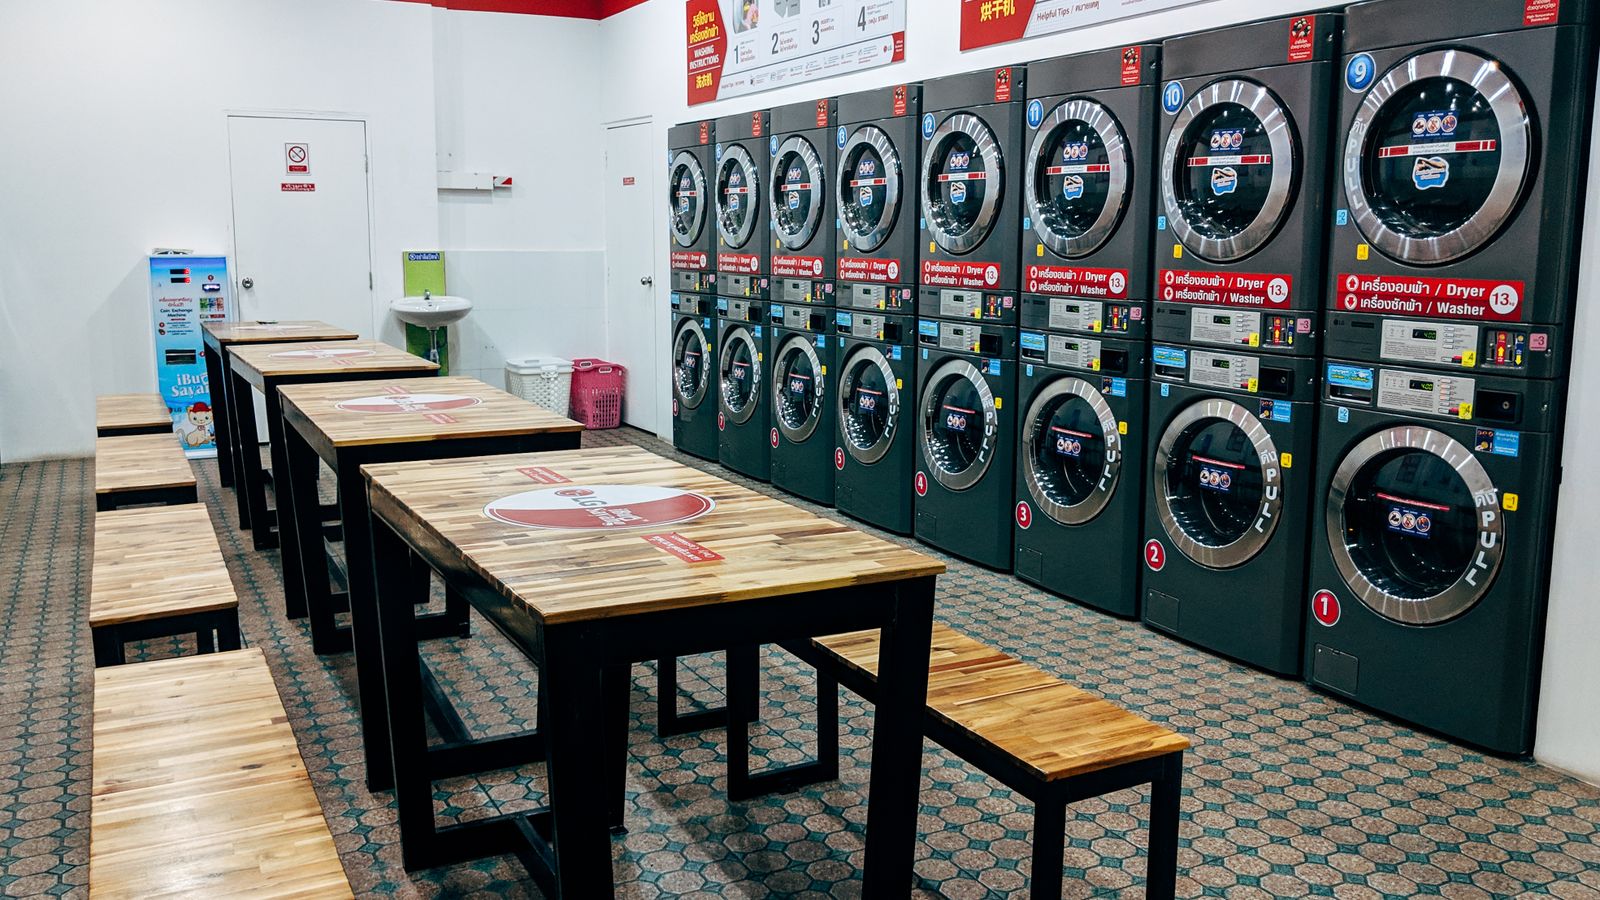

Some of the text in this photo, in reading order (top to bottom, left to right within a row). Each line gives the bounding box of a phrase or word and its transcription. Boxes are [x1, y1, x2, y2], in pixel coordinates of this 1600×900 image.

[858, 6, 866, 32] 4
[1037, 9, 1057, 20] Helpful
[1058, 7, 1070, 16] Tips
[812, 20, 820, 45] 3
[694, 45, 714, 58] WASHING
[772, 32, 779, 55] 2
[690, 54, 719, 70] INSTRUCTIONS
[734, 45, 739, 64] 1
[1354, 64, 1367, 83] 9
[1167, 87, 1181, 107] 10
[1030, 106, 1039, 122] 11
[924, 118, 932, 132] 12
[839, 132, 845, 144] 13
[1347, 140, 1363, 210] PULL
[967, 266, 984, 275] Dryer
[987, 271, 995, 279] 13
[1086, 272, 1107, 282] Dryer
[963, 278, 984, 286] Washer
[1110, 278, 1120, 288] 13
[1176, 272, 1224, 287] เครื่องอบผ้า
[1237, 278, 1264, 290] Dryer
[1361, 277, 1430, 295] เครื่องอบผ้า
[1447, 284, 1485, 299] Dryer
[1080, 286, 1107, 295] Washer
[1175, 287, 1219, 302] เครื่องซักผ้า
[1230, 295, 1264, 305] Washer
[1269, 284, 1281, 296] 13
[1360, 294, 1422, 312] เครื่องซักผ้า
[1437, 304, 1485, 316] Washer
[1492, 293, 1509, 306] 13
[812, 376, 821, 418] PULL
[885, 393, 895, 438] PULL
[772, 433, 776, 442] 6
[978, 412, 993, 463] PULL
[838, 452, 842, 463] 5
[1099, 435, 1116, 492] PULL
[918, 477, 923, 489] 4
[571, 496, 608, 506] LG
[1254, 468, 1277, 533] PULL
[1020, 507, 1026, 521] 3
[1150, 546, 1158, 562] 2
[1465, 511, 1496, 586] PULL
[1320, 597, 1328, 616] 1
